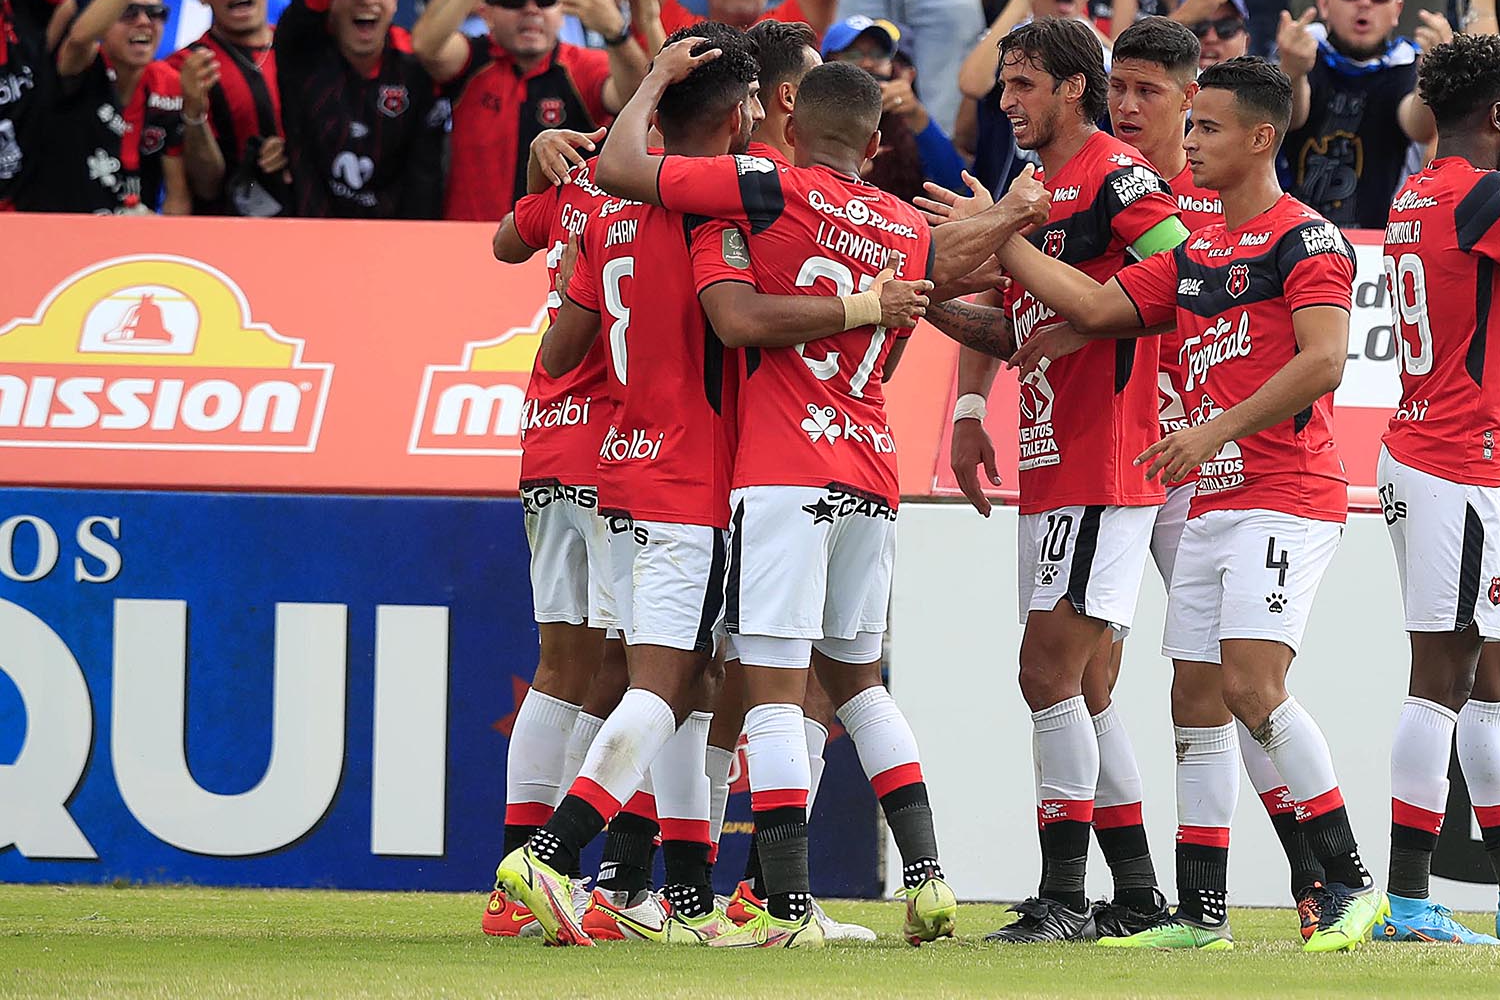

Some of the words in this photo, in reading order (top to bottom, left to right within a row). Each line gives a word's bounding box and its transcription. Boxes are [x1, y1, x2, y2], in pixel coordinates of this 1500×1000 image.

[808, 189, 848, 219] Dos
[867, 211, 918, 240] Pinos
[1178, 195, 1222, 214] Mobil
[816, 221, 907, 277] I.LAWRENE
[1238, 231, 1273, 248] Mobil
[1178, 311, 1252, 392] Tropical
[533, 488, 599, 509] CARS
[1040, 514, 1078, 563] 10
[1265, 537, 1289, 587] 4
